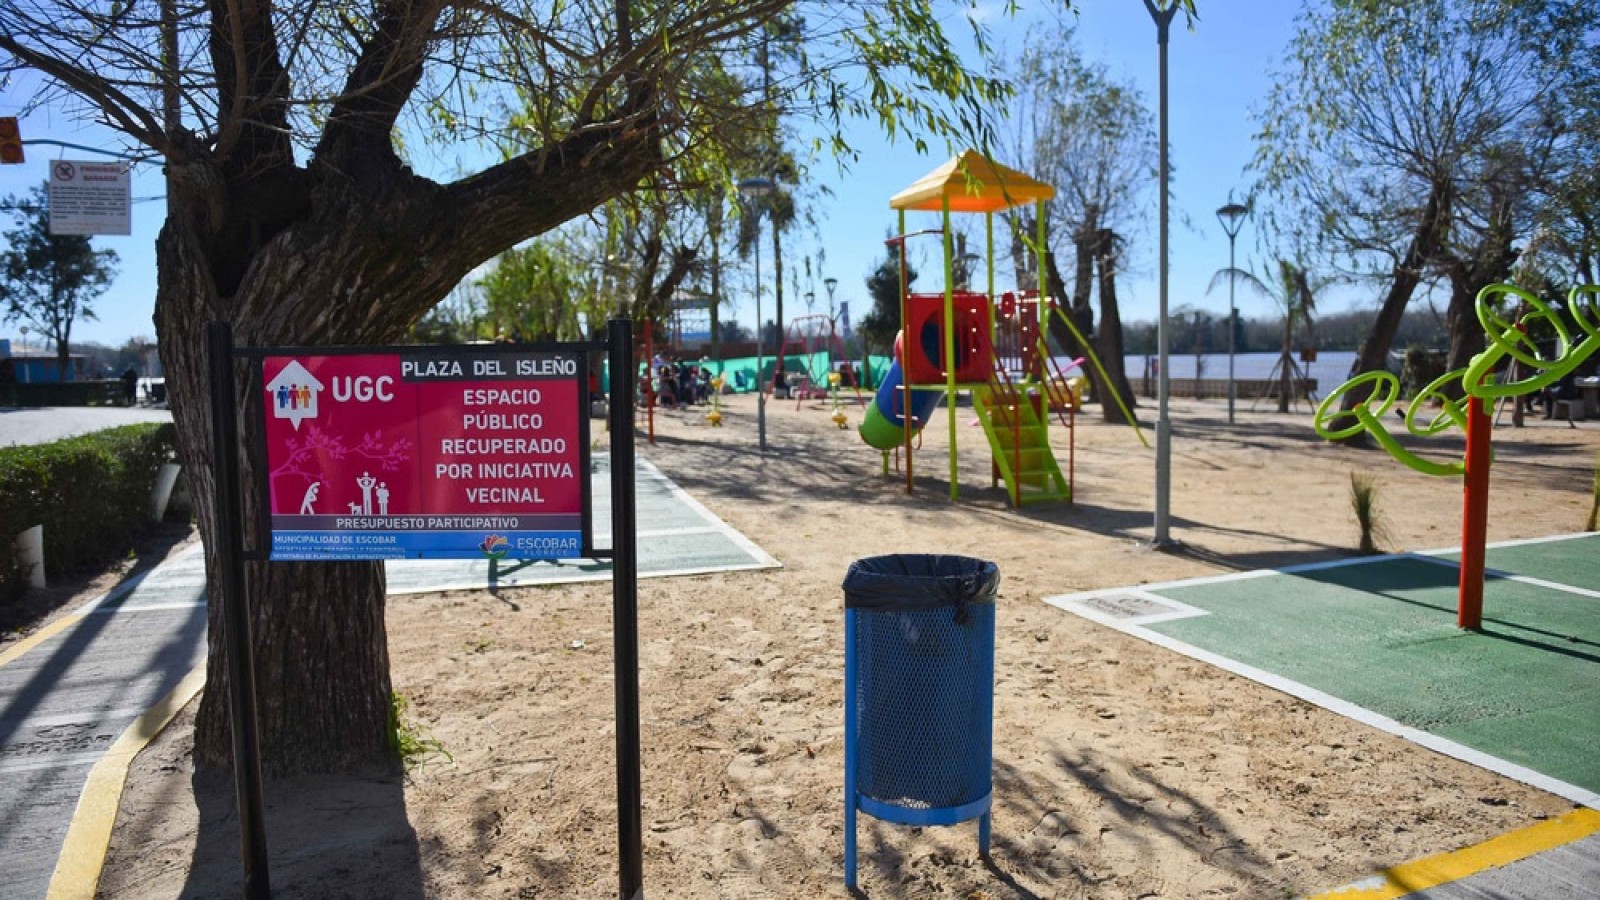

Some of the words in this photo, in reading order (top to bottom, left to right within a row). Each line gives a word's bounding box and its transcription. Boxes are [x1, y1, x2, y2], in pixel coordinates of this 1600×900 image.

[402, 361, 463, 377] PLAZA
[473, 360, 507, 376] DEL
[516, 356, 577, 376] ISLEÑO
[332, 375, 394, 403] UGC
[463, 388, 541, 405] ESPACIO
[463, 409, 543, 430] PÚBLICO
[441, 438, 566, 455] RECUPERADO
[436, 463, 473, 479] POR
[478, 462, 574, 479] INICIATIVA
[466, 487, 545, 503] VECINAL
[336, 517, 425, 529] PRESUPUESTO
[428, 517, 519, 529] PARTICIPATIVO
[274, 535, 340, 544] MUNICIPALIDAD
[343, 535, 353, 544] DE
[356, 535, 396, 544] ESCOBAR
[517, 537, 577, 549] ESCOBAR
